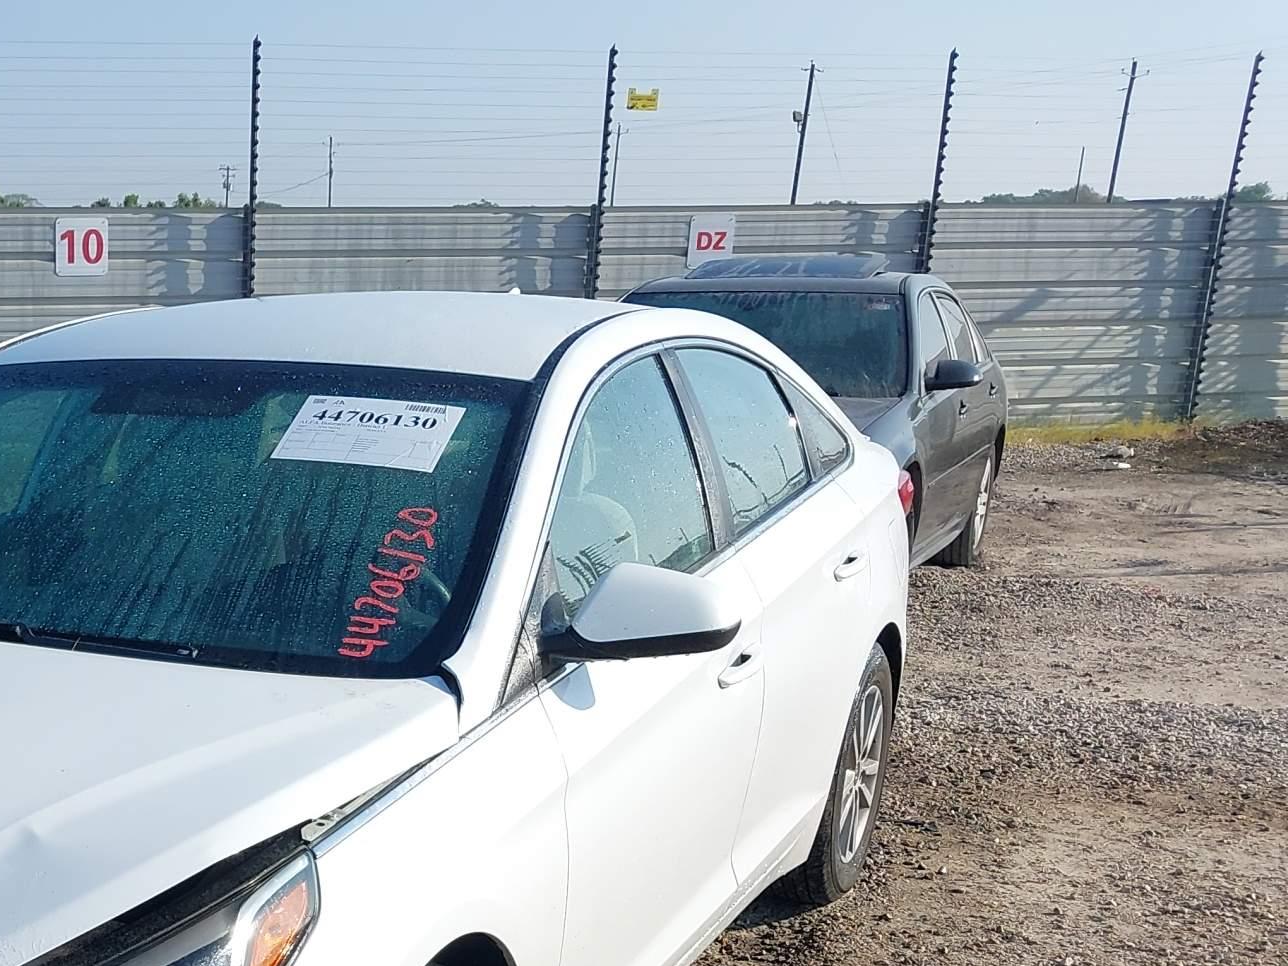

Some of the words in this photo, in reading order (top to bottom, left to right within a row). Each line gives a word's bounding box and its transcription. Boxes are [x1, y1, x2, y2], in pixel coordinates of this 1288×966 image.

[60, 229, 104, 264] 10
[696, 232, 727, 250] DZ
[313, 409, 438, 430] 44706130
[338, 507, 438, 658] 44706130
